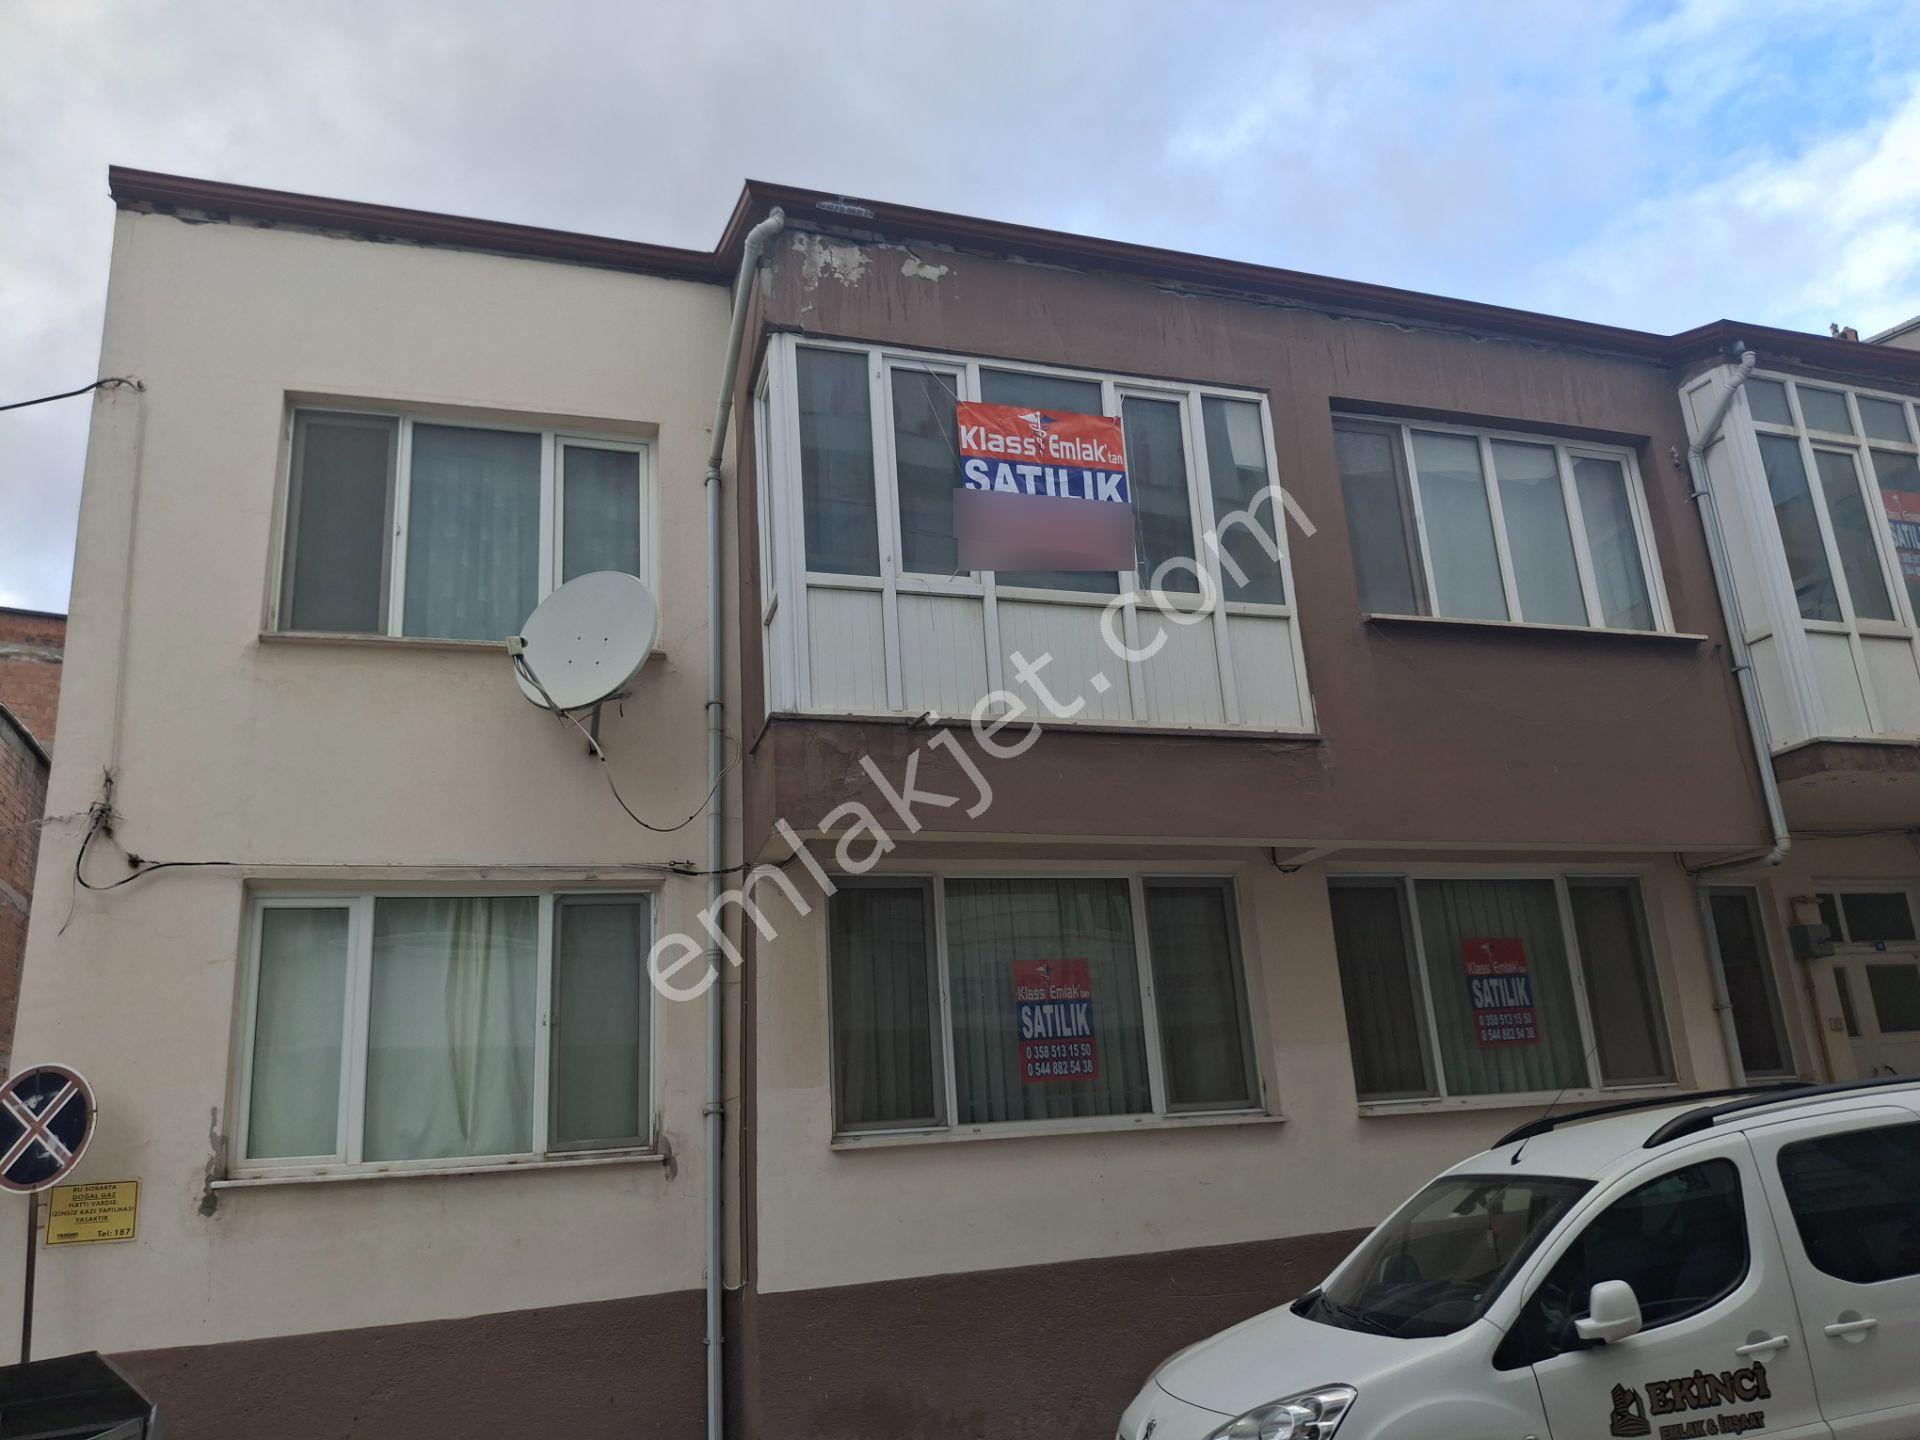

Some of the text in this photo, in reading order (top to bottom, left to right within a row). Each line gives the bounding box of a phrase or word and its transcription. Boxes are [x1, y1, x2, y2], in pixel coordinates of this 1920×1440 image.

[960, 425, 1036, 456] Klass
[964, 458, 1124, 503] SATILIK
[1017, 986, 1046, 1001] Klass
[1472, 977, 1531, 1009] SATILIK
[1021, 1003, 1091, 1039] SATILIK
[1026, 1046, 1032, 1059] 0
[1051, 1044, 1067, 1058] 513
[1069, 1043, 1080, 1057] 15
[1081, 1043, 1091, 1056] 50
[1027, 1062, 1034, 1077] 0
[1035, 1061, 1051, 1076] 544
[1070, 1060, 1081, 1074] 54
[97, 1228, 131, 1238] Tel: 187
[1645, 1360, 1771, 1416] EKİNCİ
[1658, 1411, 1766, 1440] EMLAK & İNŞAAT
